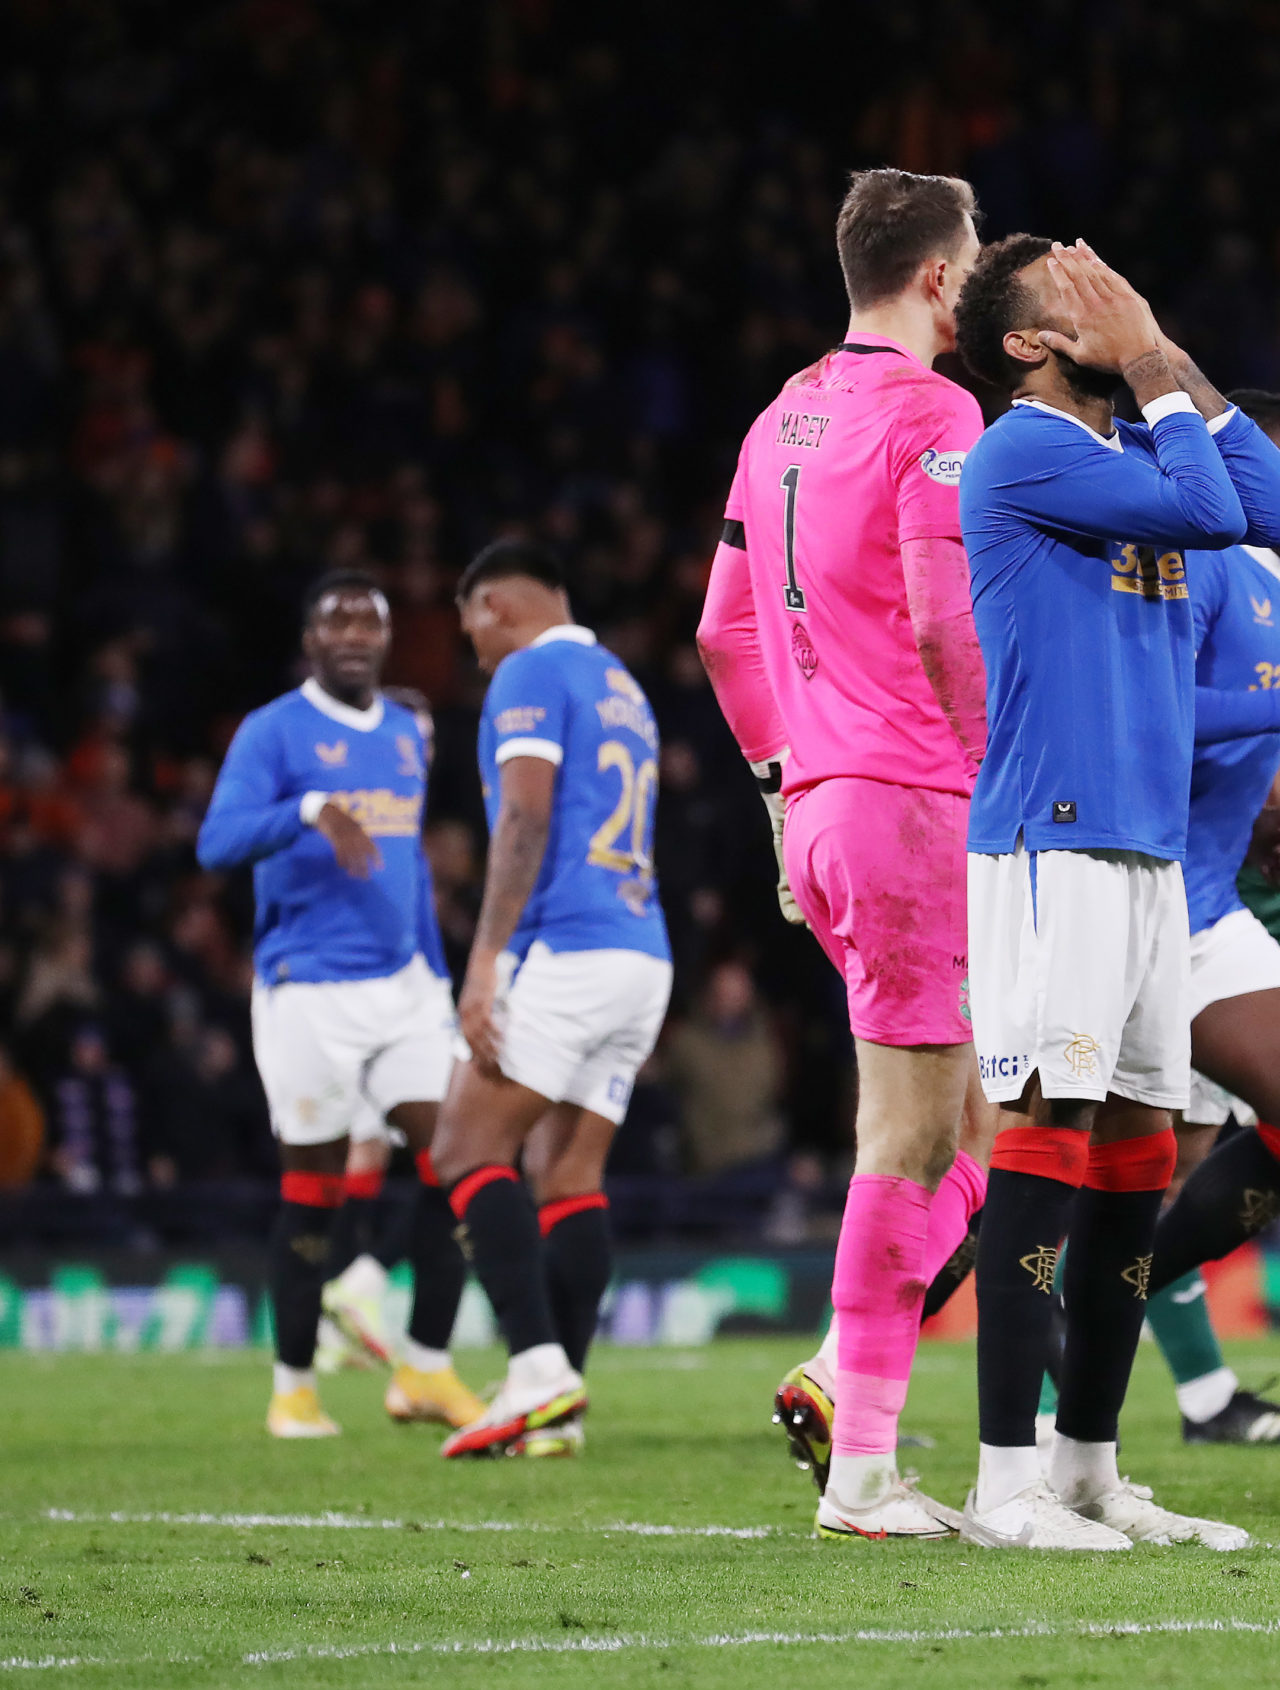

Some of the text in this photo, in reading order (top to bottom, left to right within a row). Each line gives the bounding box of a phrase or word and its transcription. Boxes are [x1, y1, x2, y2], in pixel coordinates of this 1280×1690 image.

[776, 411, 831, 449] MACEY
[779, 464, 807, 613] 1
[588, 740, 658, 872] 20
